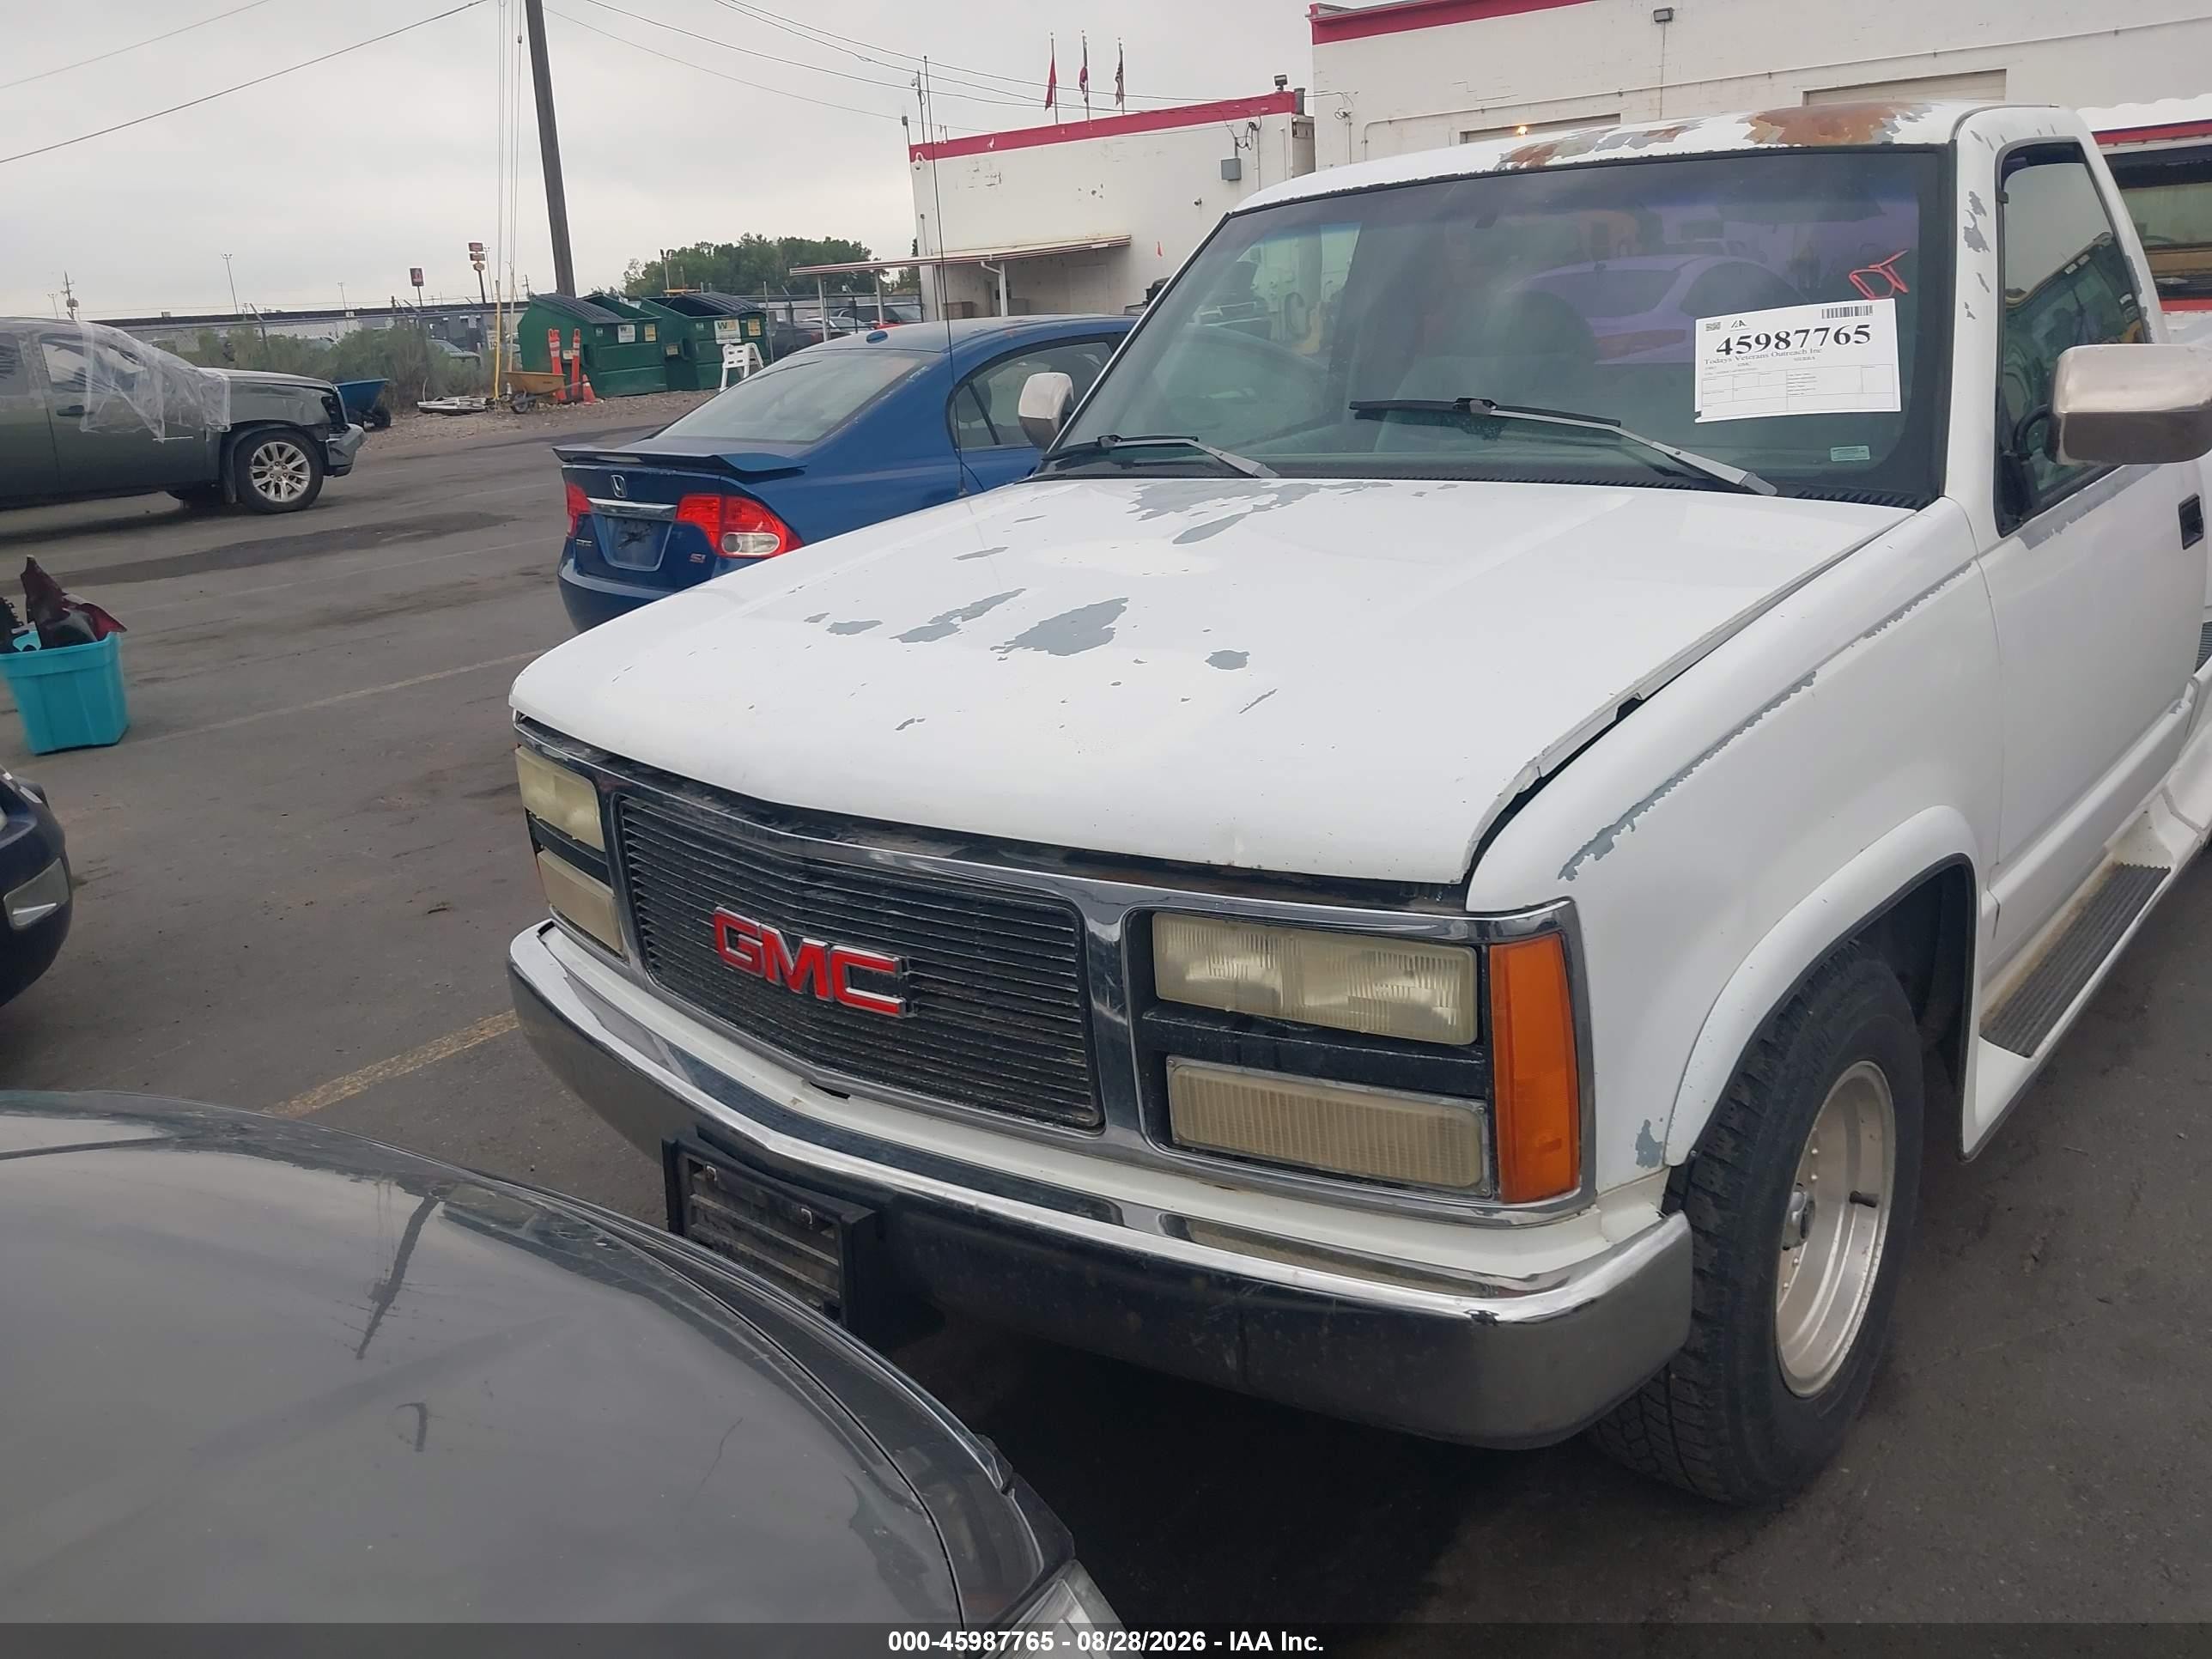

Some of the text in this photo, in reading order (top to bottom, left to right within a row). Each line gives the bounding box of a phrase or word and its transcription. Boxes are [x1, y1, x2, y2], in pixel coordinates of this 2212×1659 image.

[1716, 324, 1872, 356] 45987765
[1705, 357, 1733, 366] Todays
[1735, 353, 1770, 362] Veterans
[1771, 348, 1808, 357] Outreach
[714, 907, 908, 1018] GMC
